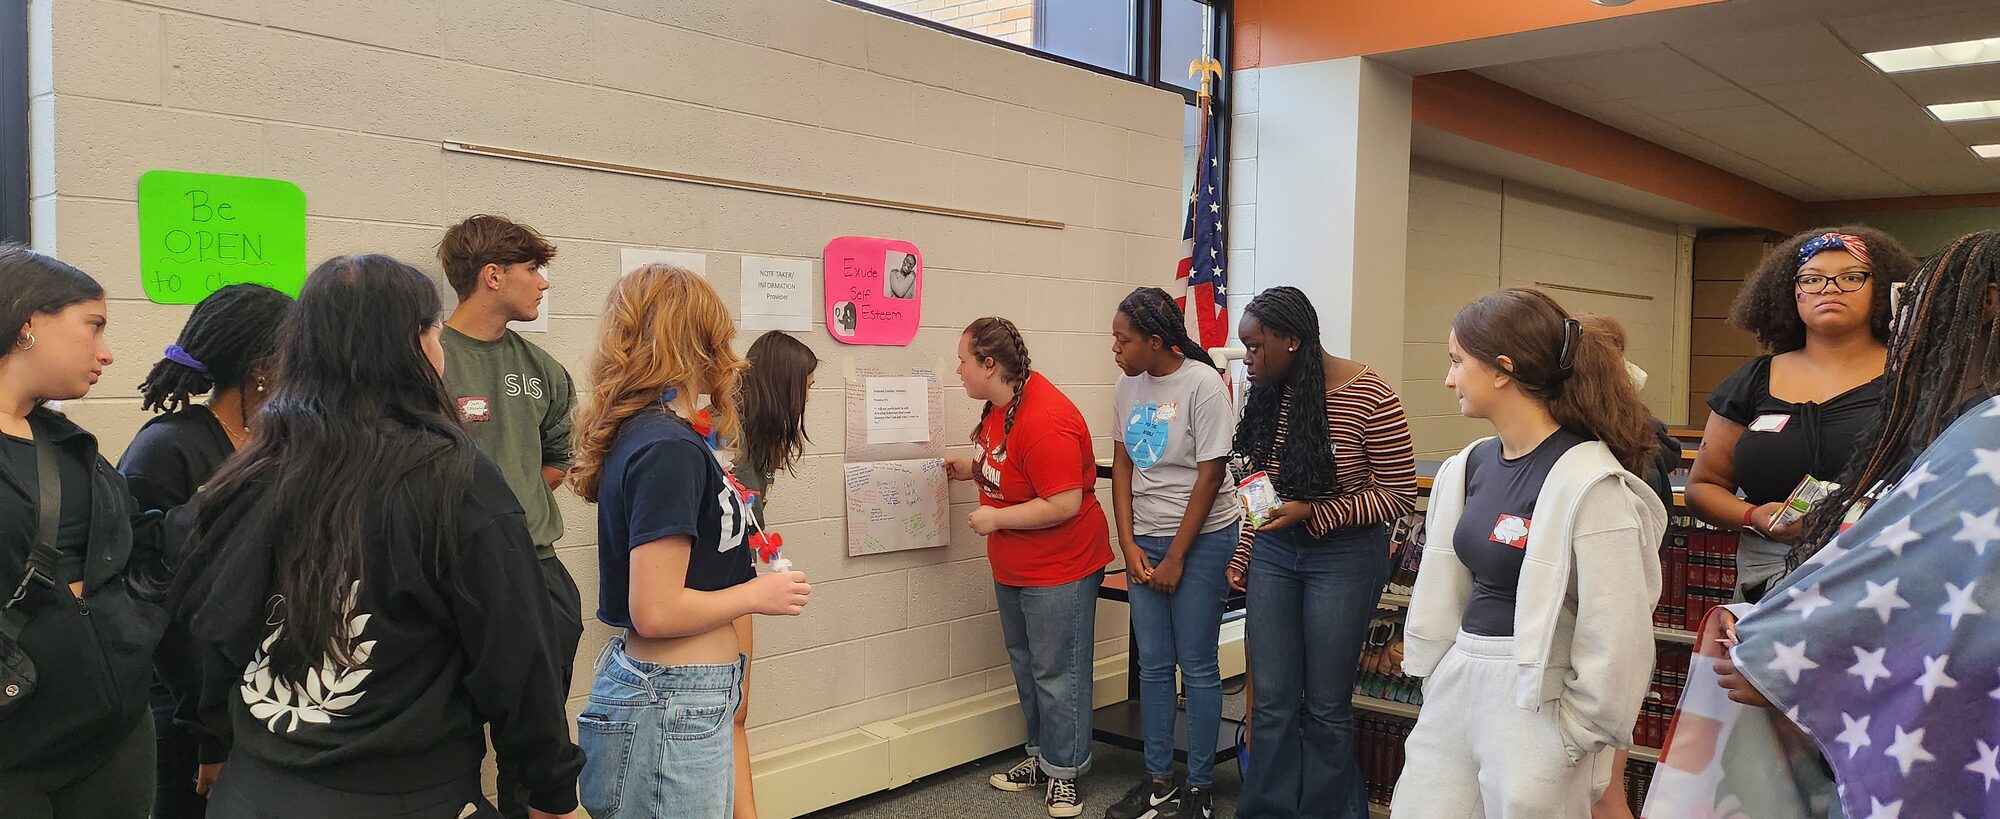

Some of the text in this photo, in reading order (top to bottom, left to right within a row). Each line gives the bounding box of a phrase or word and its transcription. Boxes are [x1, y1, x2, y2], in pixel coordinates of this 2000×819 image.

[184, 190, 236, 222] Be
[164, 229, 262, 262] OPEN
[843, 258, 878, 278] Exude
[151, 271, 182, 292] to
[758, 282, 796, 290] INFORMATION
[850, 286, 872, 301] Self
[861, 304, 902, 321] Esteem
[504, 373, 543, 399] SLS
